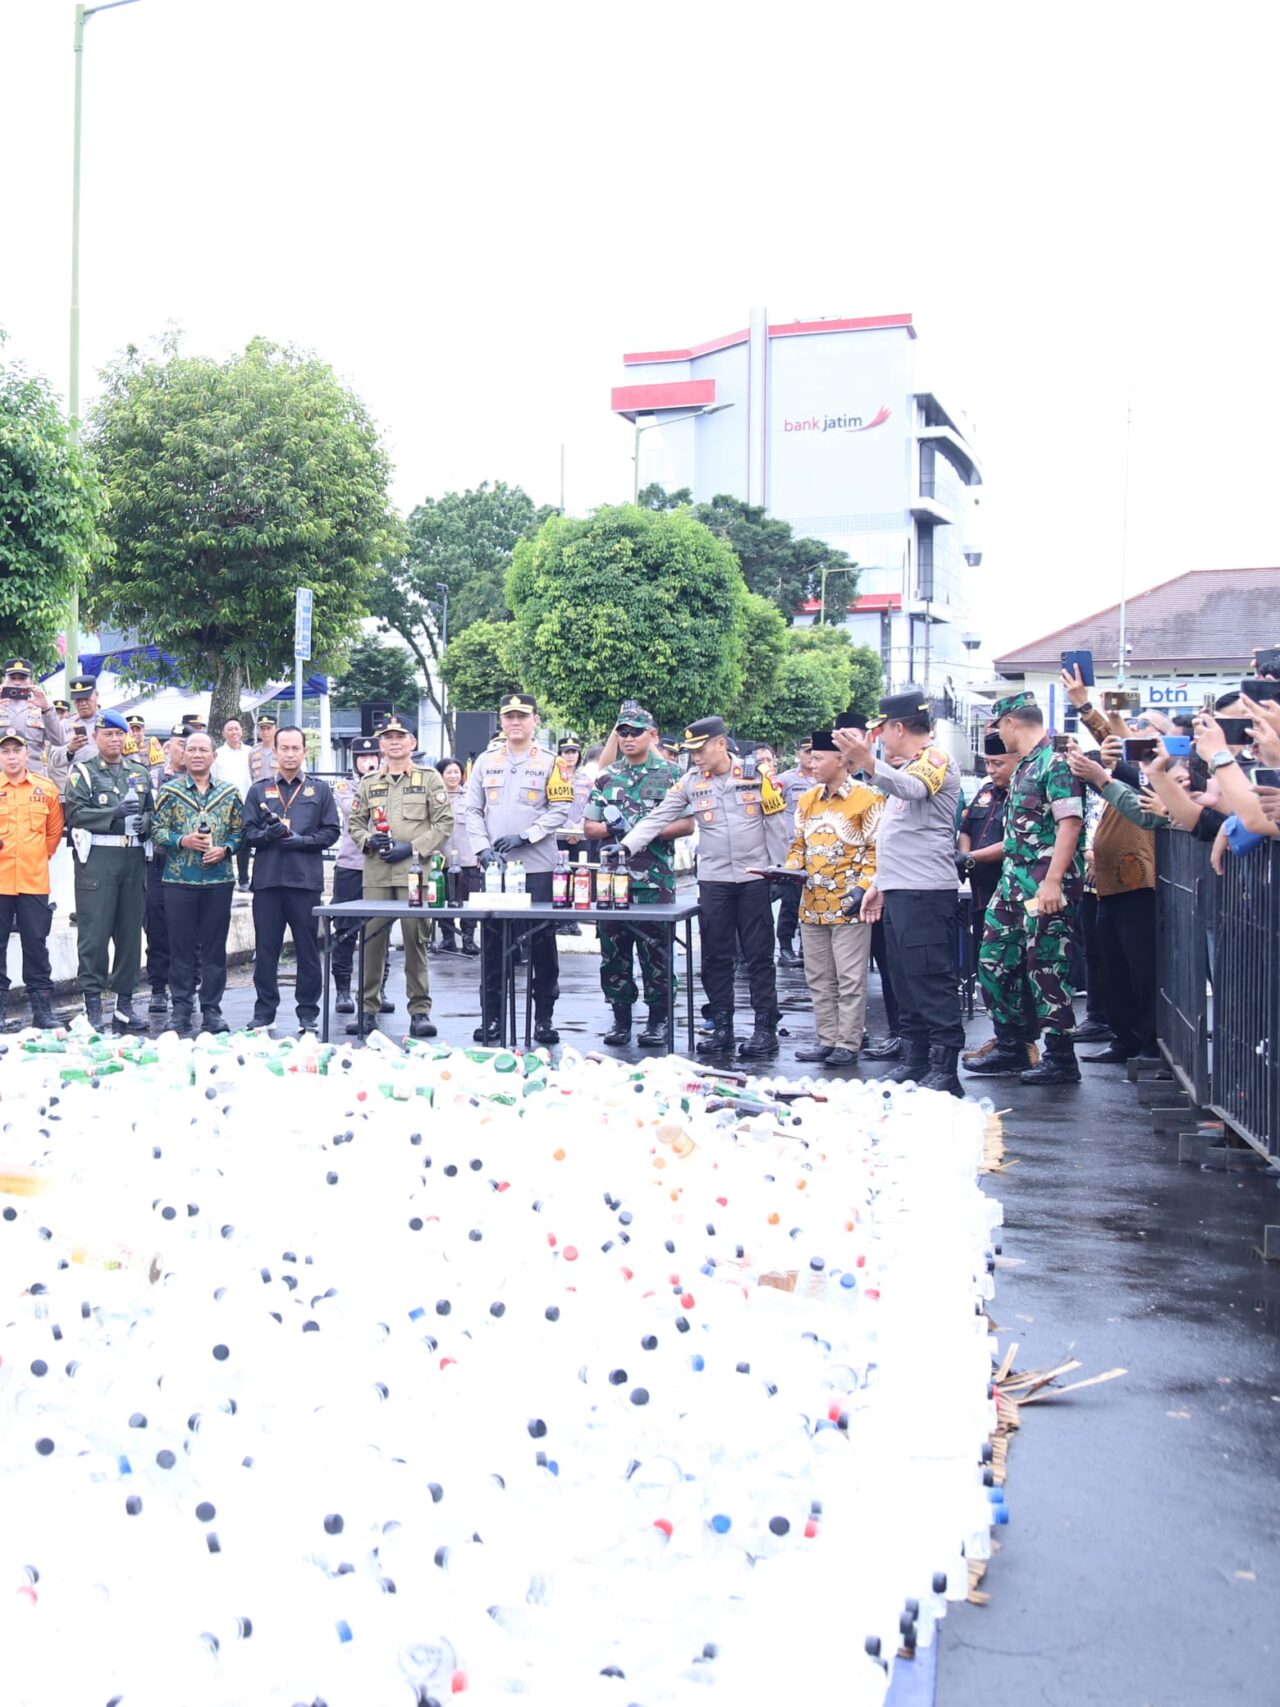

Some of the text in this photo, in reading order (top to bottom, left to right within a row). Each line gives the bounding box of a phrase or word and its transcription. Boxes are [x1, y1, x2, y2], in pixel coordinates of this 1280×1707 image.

[783, 414, 862, 432] bank jatim
[1150, 685, 1187, 703] btn
[735, 784, 760, 792] POLRI
